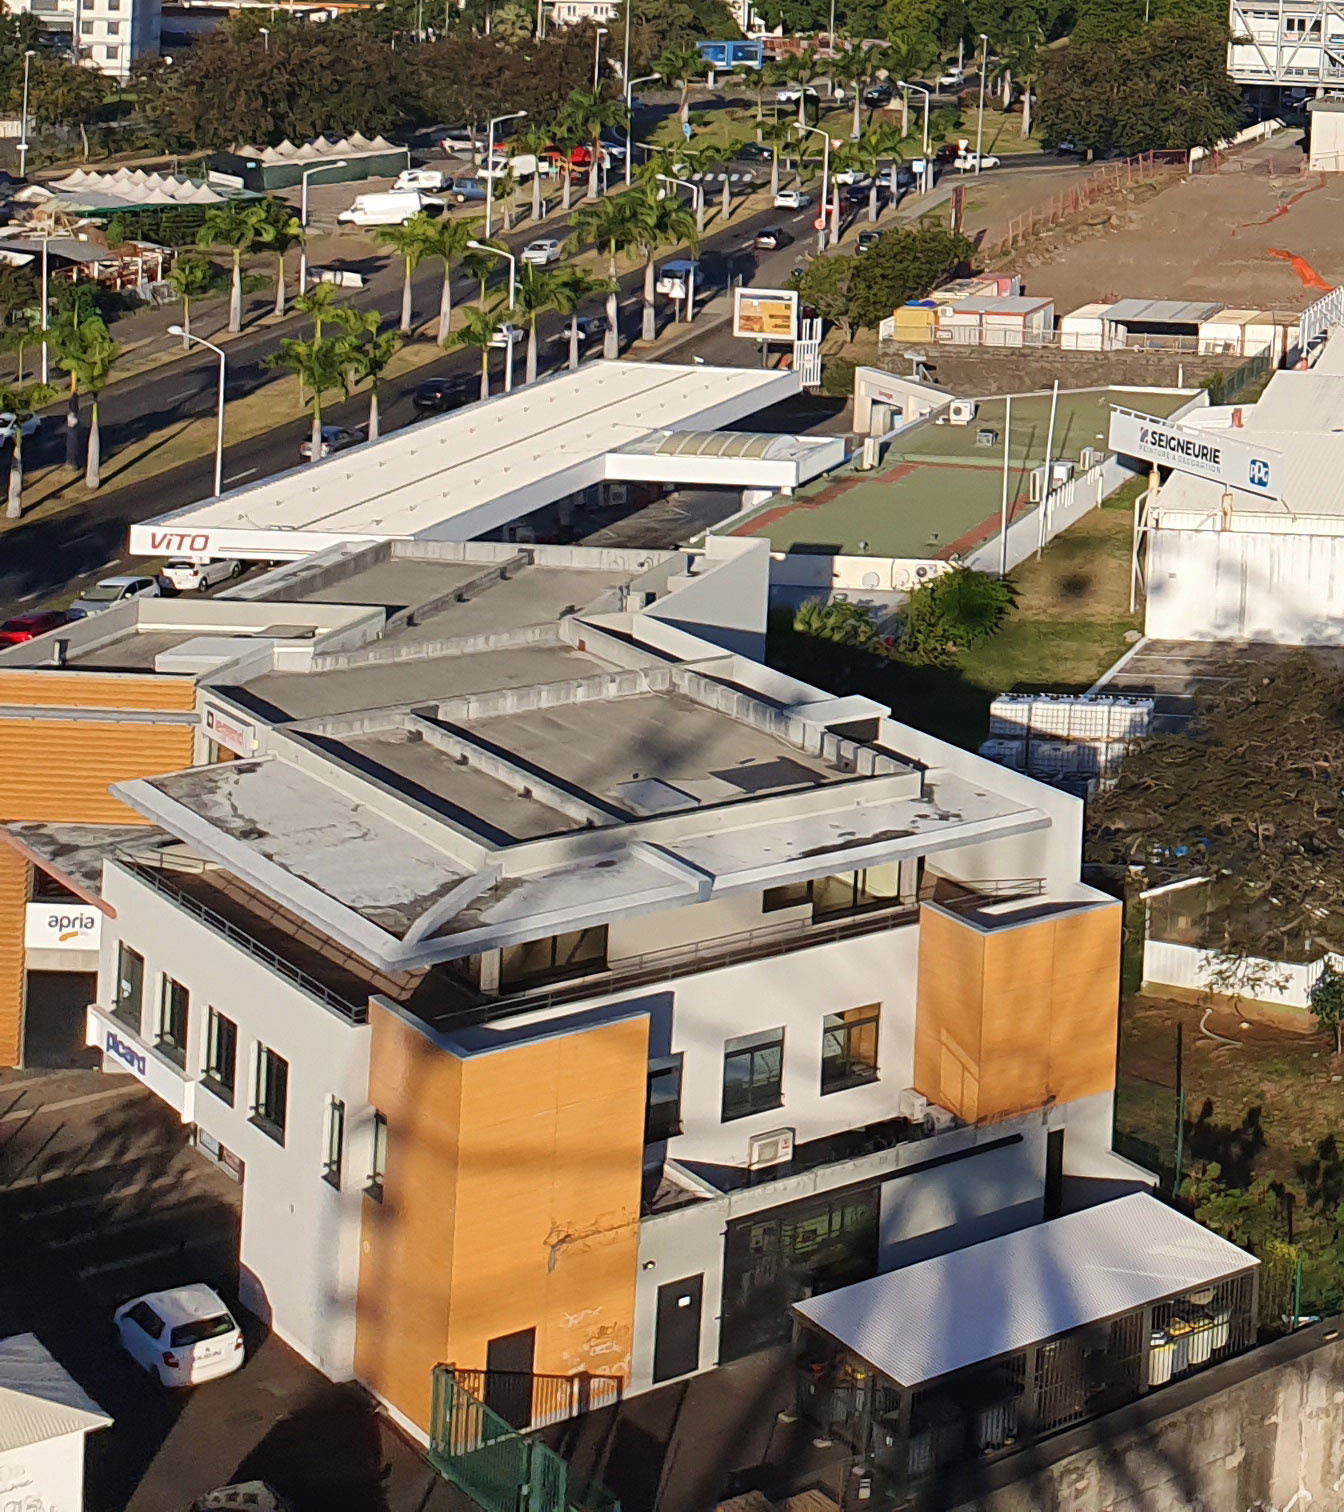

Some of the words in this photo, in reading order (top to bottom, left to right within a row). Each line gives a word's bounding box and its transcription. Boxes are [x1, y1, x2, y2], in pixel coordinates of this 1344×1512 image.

[1150, 430, 1221, 465] SEIGNEURIE
[1250, 461, 1269, 484] PPG
[47, 912, 96, 932] apria
[105, 1030, 147, 1077] picard
